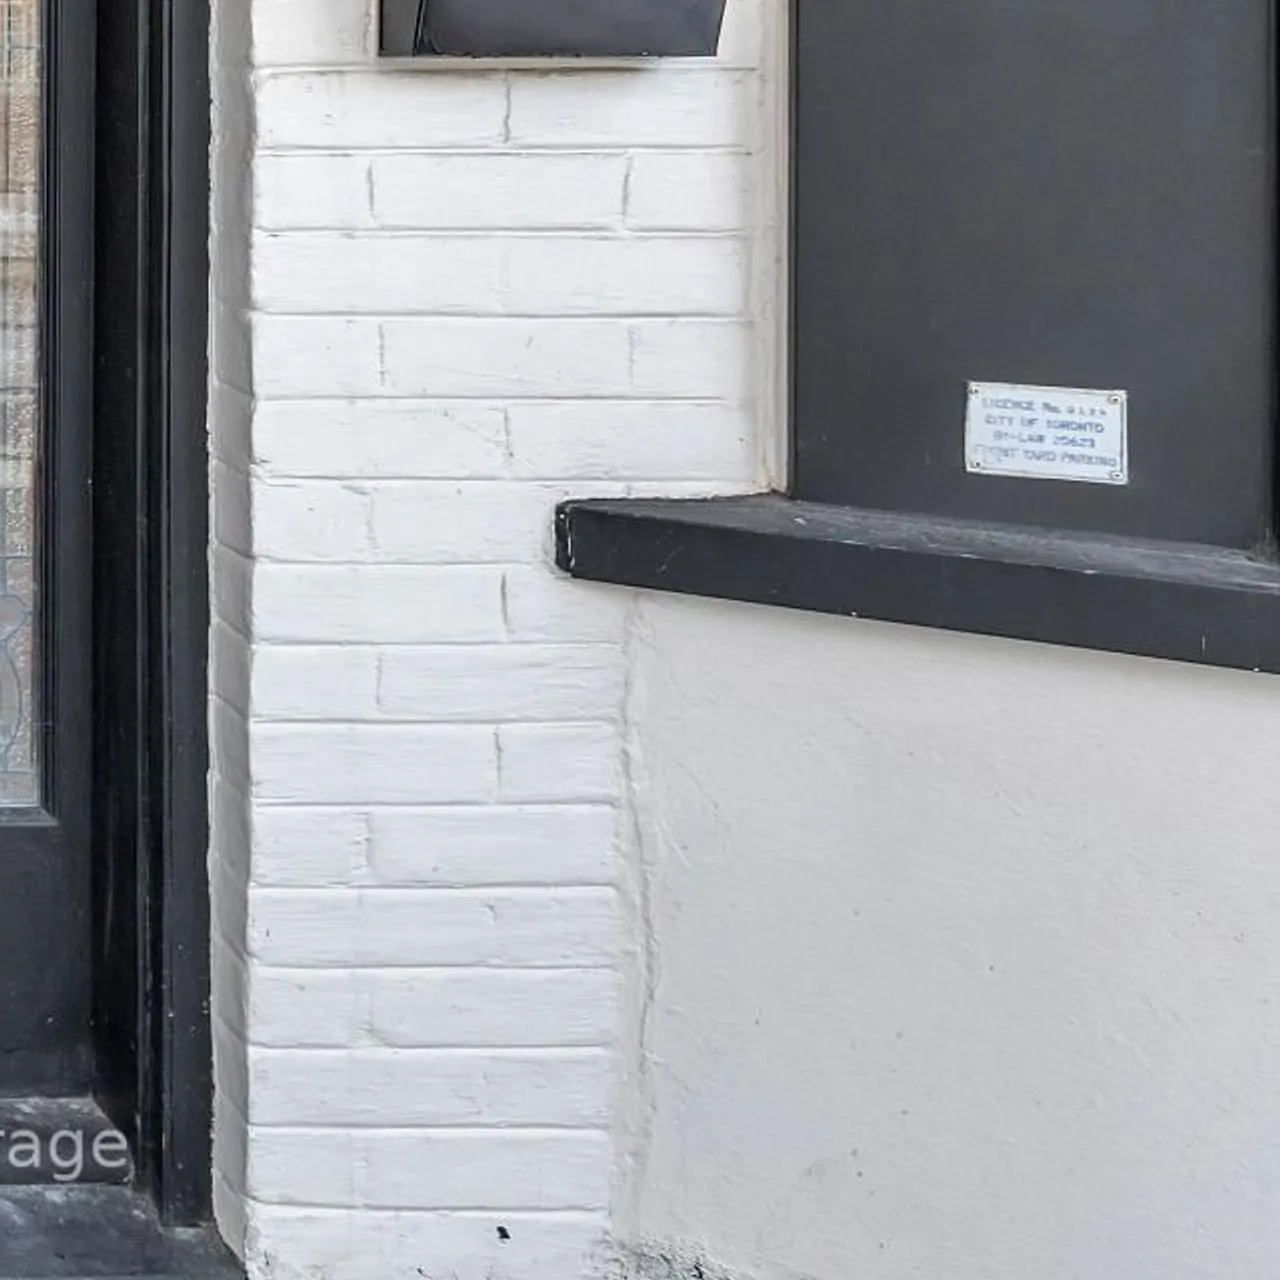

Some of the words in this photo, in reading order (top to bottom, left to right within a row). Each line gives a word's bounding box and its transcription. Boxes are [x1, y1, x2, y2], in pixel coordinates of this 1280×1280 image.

[984, 414, 1014, 425] CITY
[1020, 416, 1039, 427] OF
[1046, 419, 1105, 434] TORONTO
